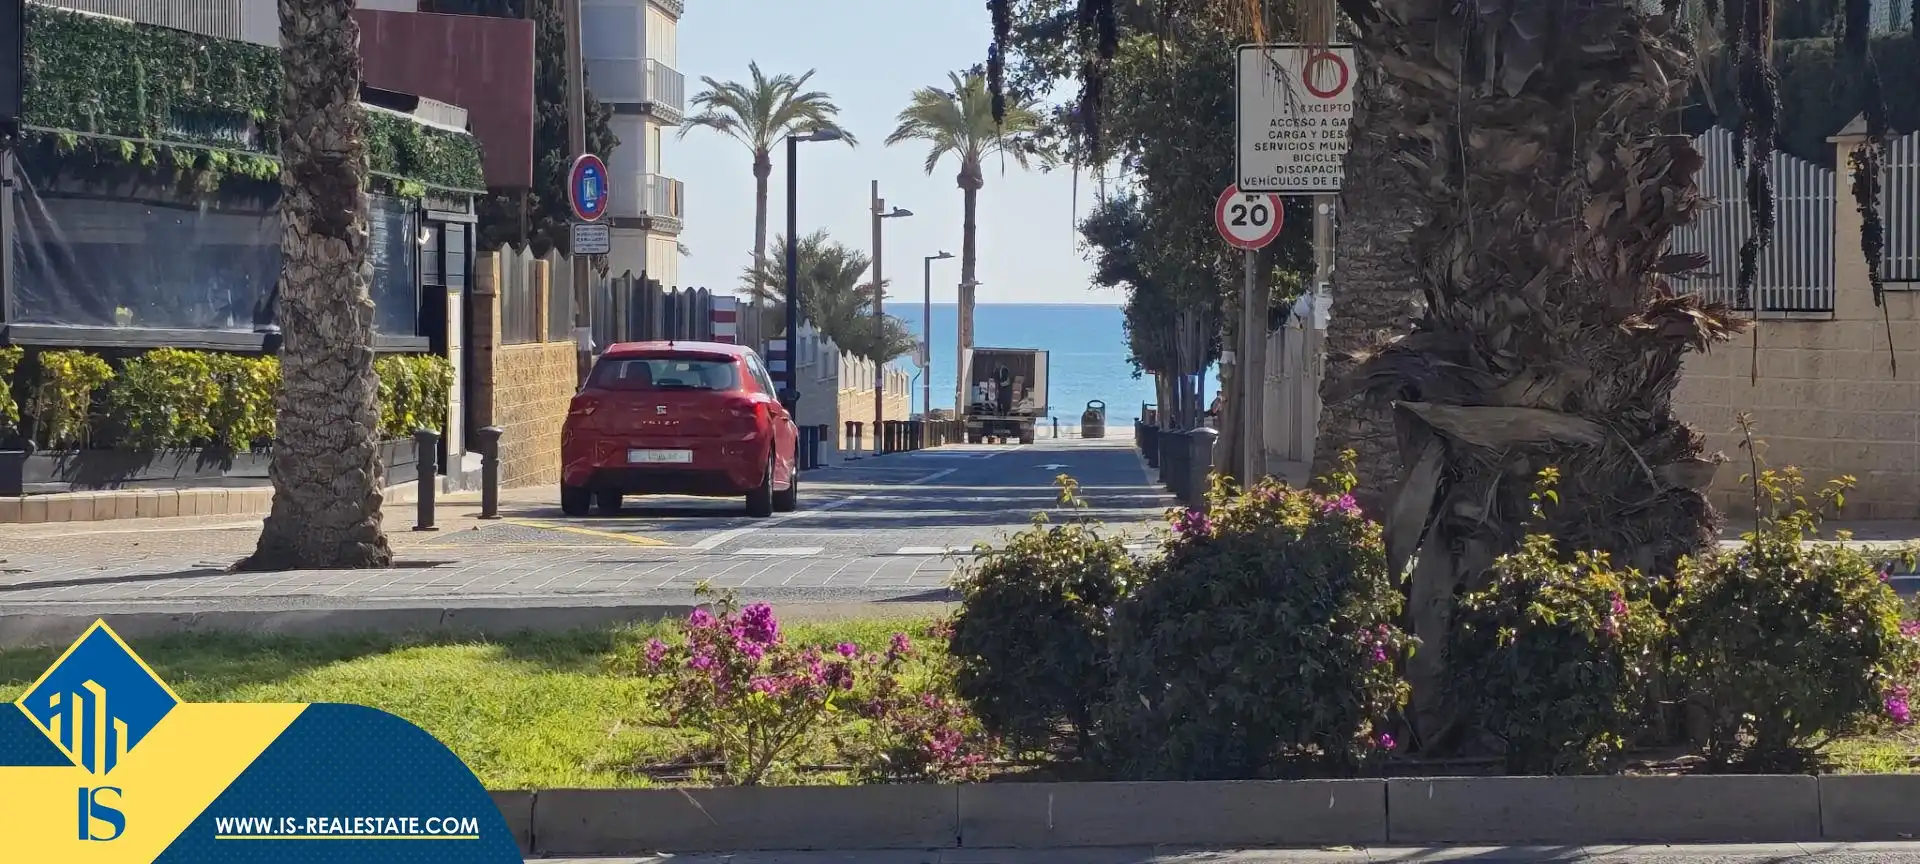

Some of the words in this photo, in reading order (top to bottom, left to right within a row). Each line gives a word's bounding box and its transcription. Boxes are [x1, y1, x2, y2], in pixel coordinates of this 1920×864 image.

[1270, 118, 1316, 127] ACCESO
[1320, 118, 1328, 127] A
[1268, 130, 1307, 139] CARGA
[1311, 130, 1317, 139] Y
[1254, 142, 1315, 151] SERVICIOS
[1312, 176, 1327, 186] DE
[1231, 203, 1269, 227] 20
